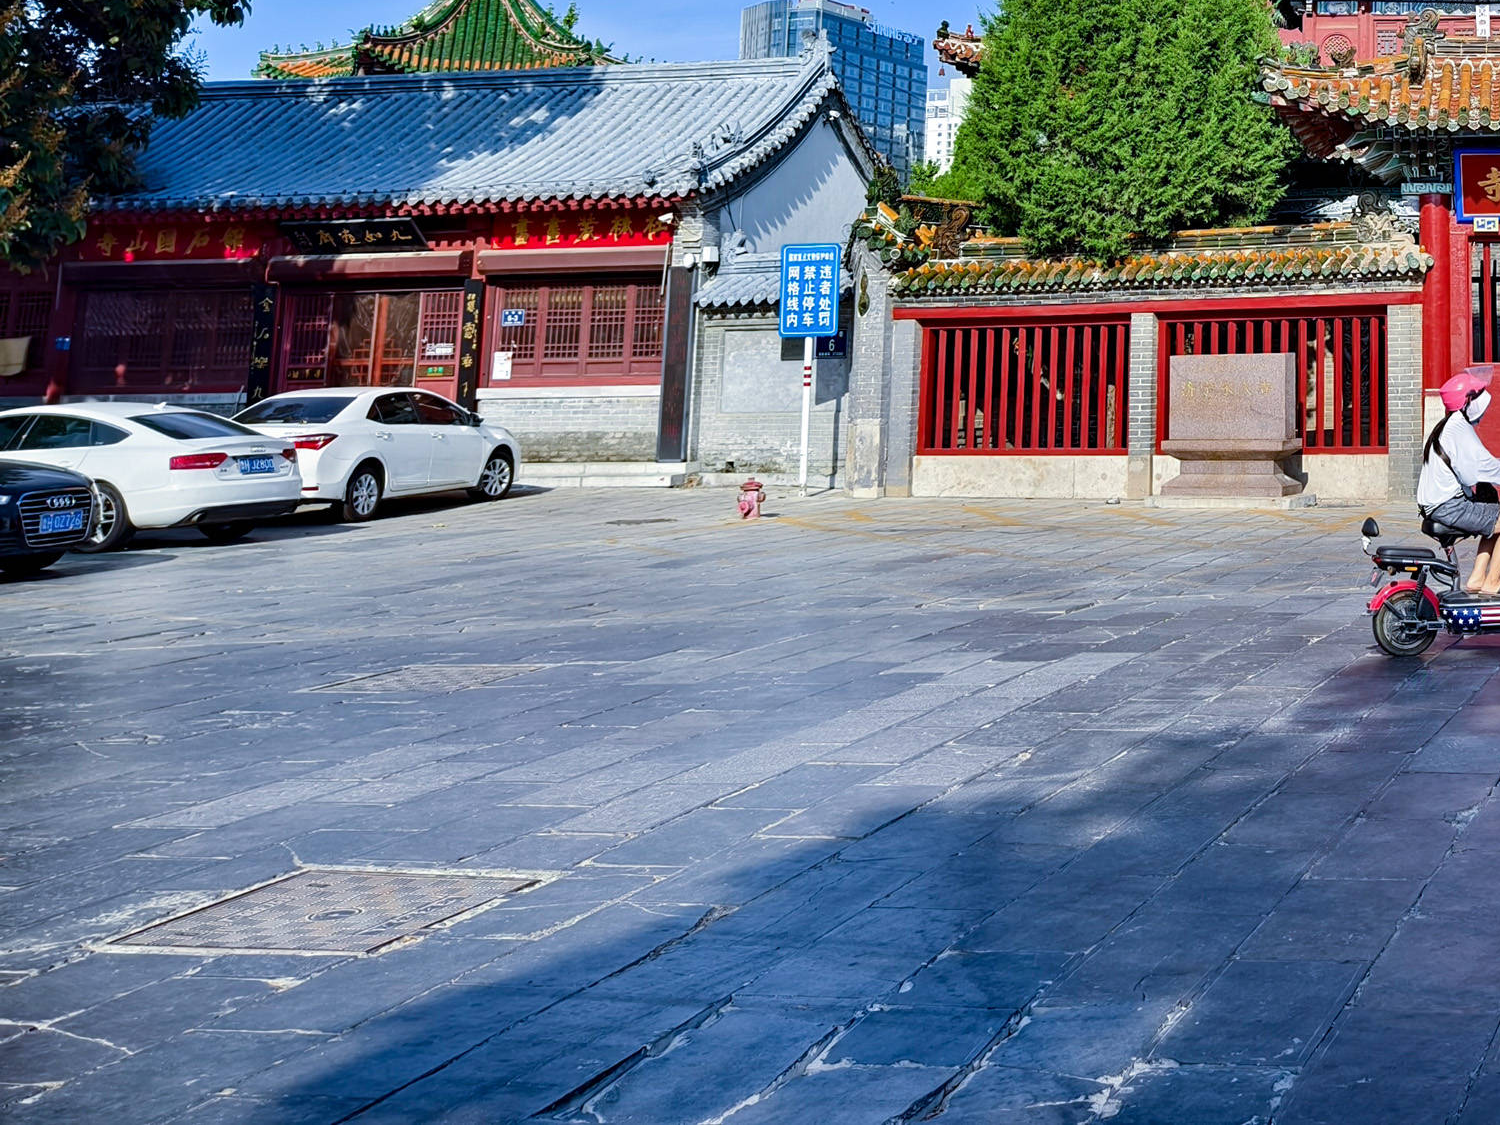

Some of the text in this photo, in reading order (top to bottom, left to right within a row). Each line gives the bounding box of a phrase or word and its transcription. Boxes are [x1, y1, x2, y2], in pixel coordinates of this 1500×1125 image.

[787, 266, 800, 328] 网格线内
[802, 265, 816, 327] 禁止停车
[818, 265, 832, 326] 违者处罚
[829, 339, 834, 351] 6
